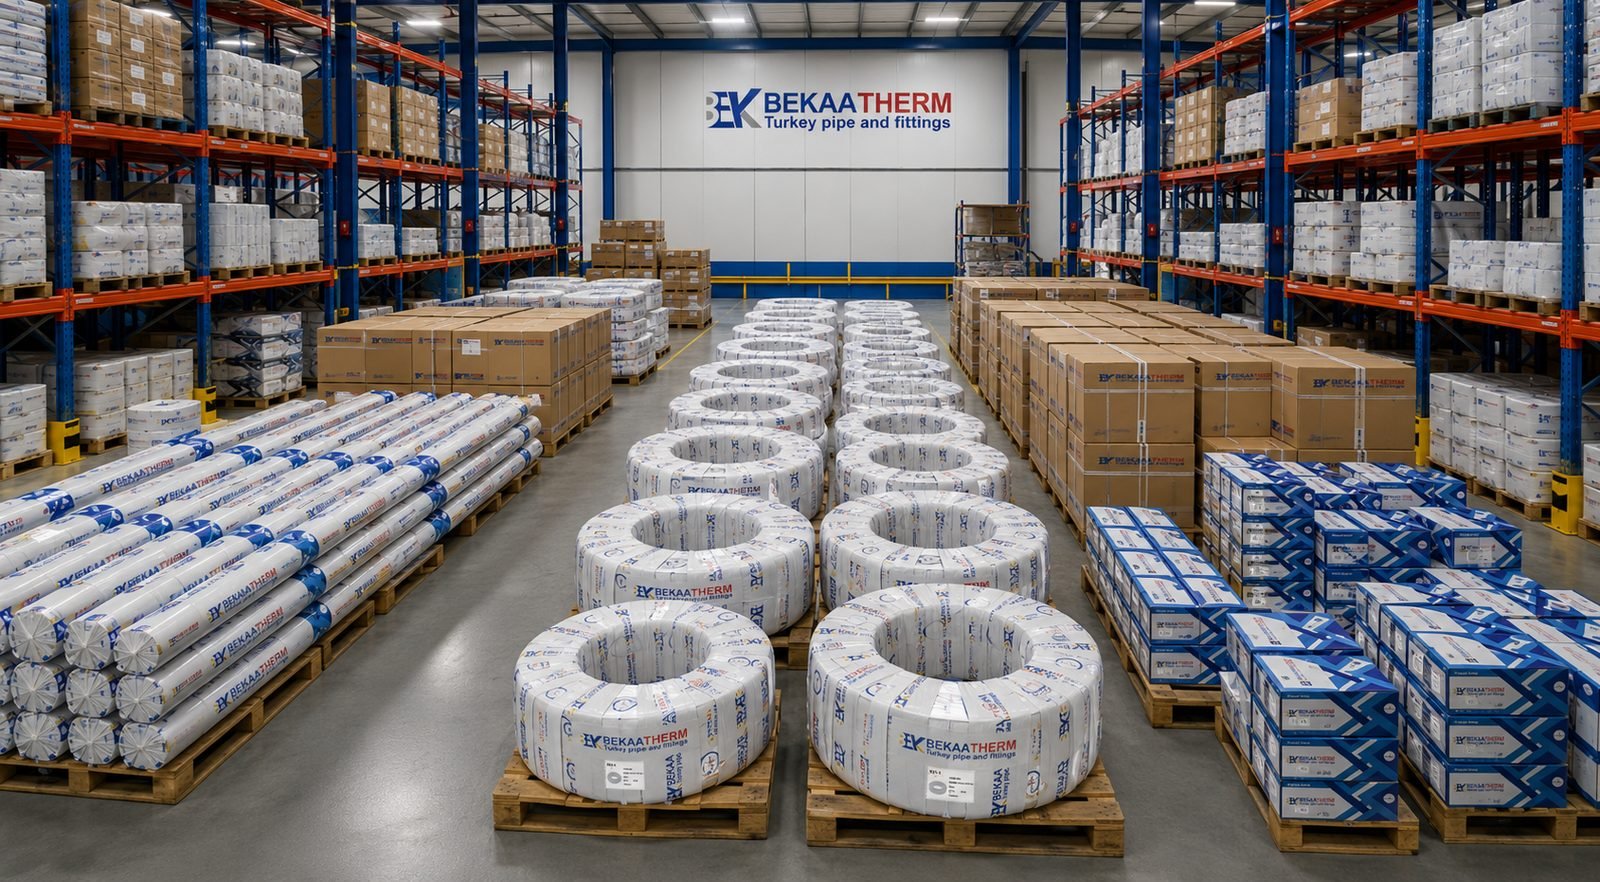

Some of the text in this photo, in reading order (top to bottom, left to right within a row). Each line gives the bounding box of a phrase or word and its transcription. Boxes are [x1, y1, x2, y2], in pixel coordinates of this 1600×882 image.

[764, 92, 952, 113] BEKAATHERM
[764, 116, 951, 131] Turkey pipe and fittings
[655, 584, 733, 597] BEKAATHERM
[603, 728, 688, 747] BEKAATHERM
[926, 738, 1017, 753] BEKAATHERM
